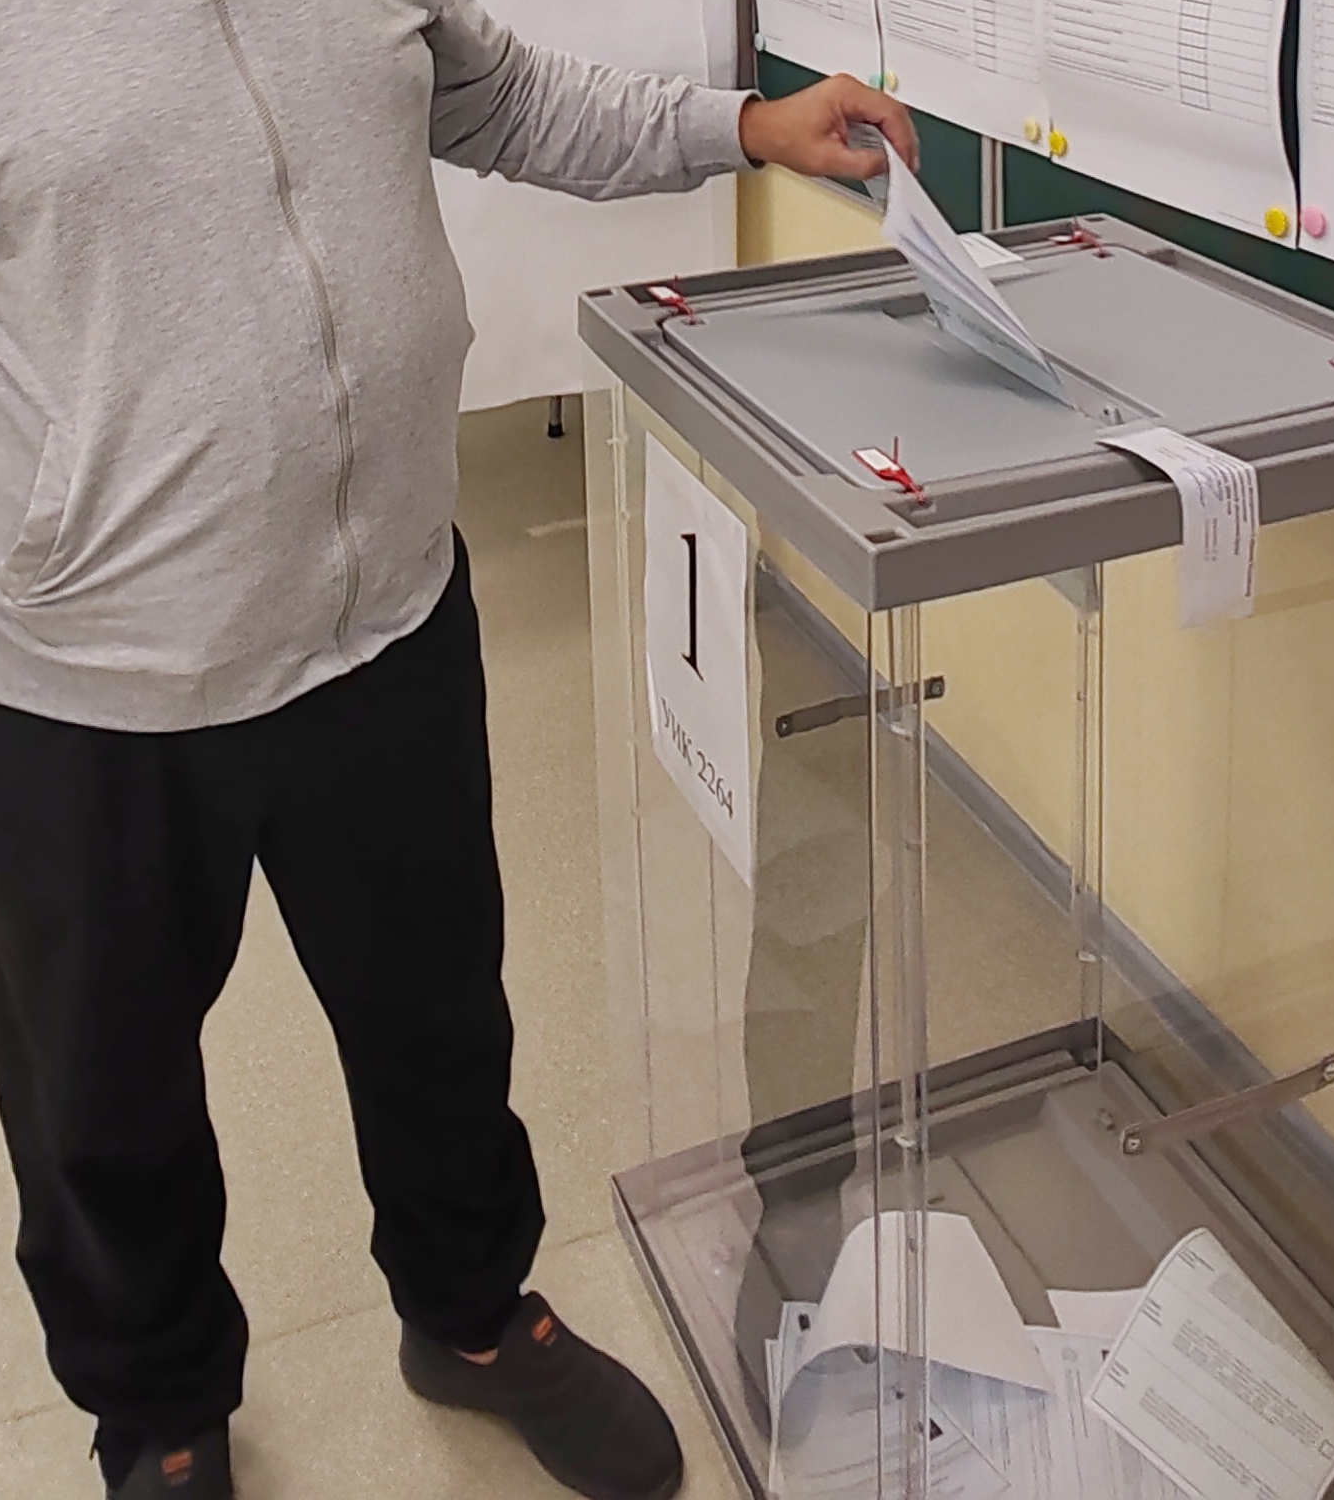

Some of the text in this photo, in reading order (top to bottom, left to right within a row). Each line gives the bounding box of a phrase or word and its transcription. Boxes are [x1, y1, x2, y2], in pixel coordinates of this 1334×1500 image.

[680, 533, 705, 683] 1
[661, 696, 734, 820] УИК 2264
